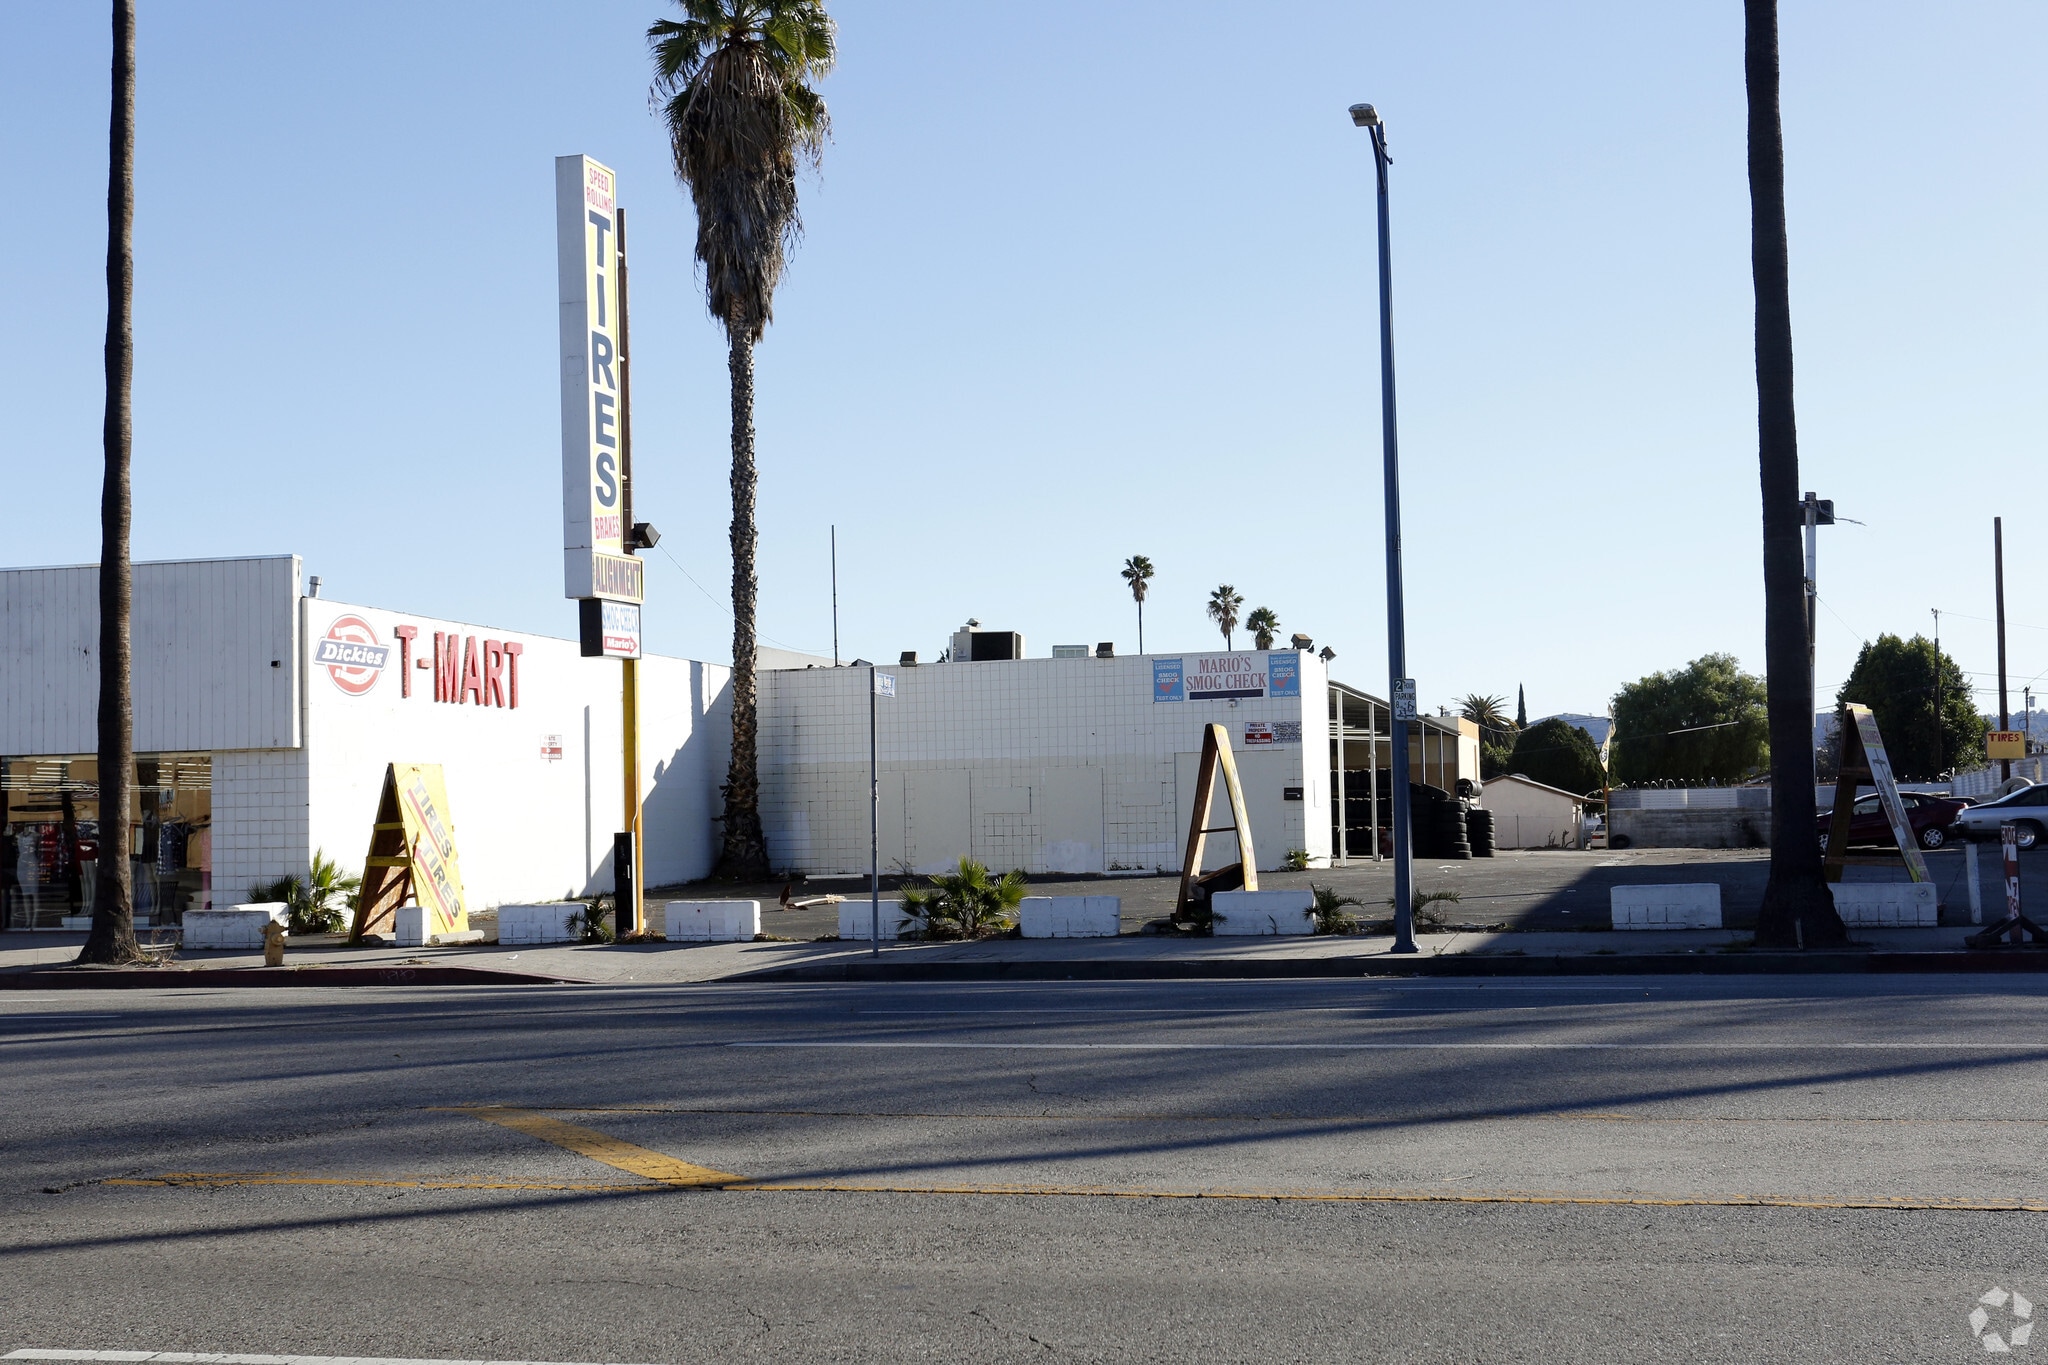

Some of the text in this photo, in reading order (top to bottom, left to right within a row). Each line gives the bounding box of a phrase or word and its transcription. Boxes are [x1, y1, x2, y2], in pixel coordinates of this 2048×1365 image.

[589, 167, 609, 193] SPEED
[586, 186, 612, 215] ROLLING
[589, 210, 617, 508] TIRES
[594, 516, 620, 540] BRAKES
[595, 556, 641, 598] ALIGNMENT
[602, 604, 640, 634] SMOG CHECK
[321, 643, 384, 666] Dickies
[606, 637, 635, 651] Mario's
[394, 624, 523, 710] T-MART
[1199, 657, 1252, 673] MARIO'S
[1186, 672, 1267, 691] SMOG CHECK
[1396, 680, 1402, 691] 2
[1987, 733, 2020, 742] TIRES
[413, 776, 452, 860] TIRES
[421, 837, 462, 919] TIRES
